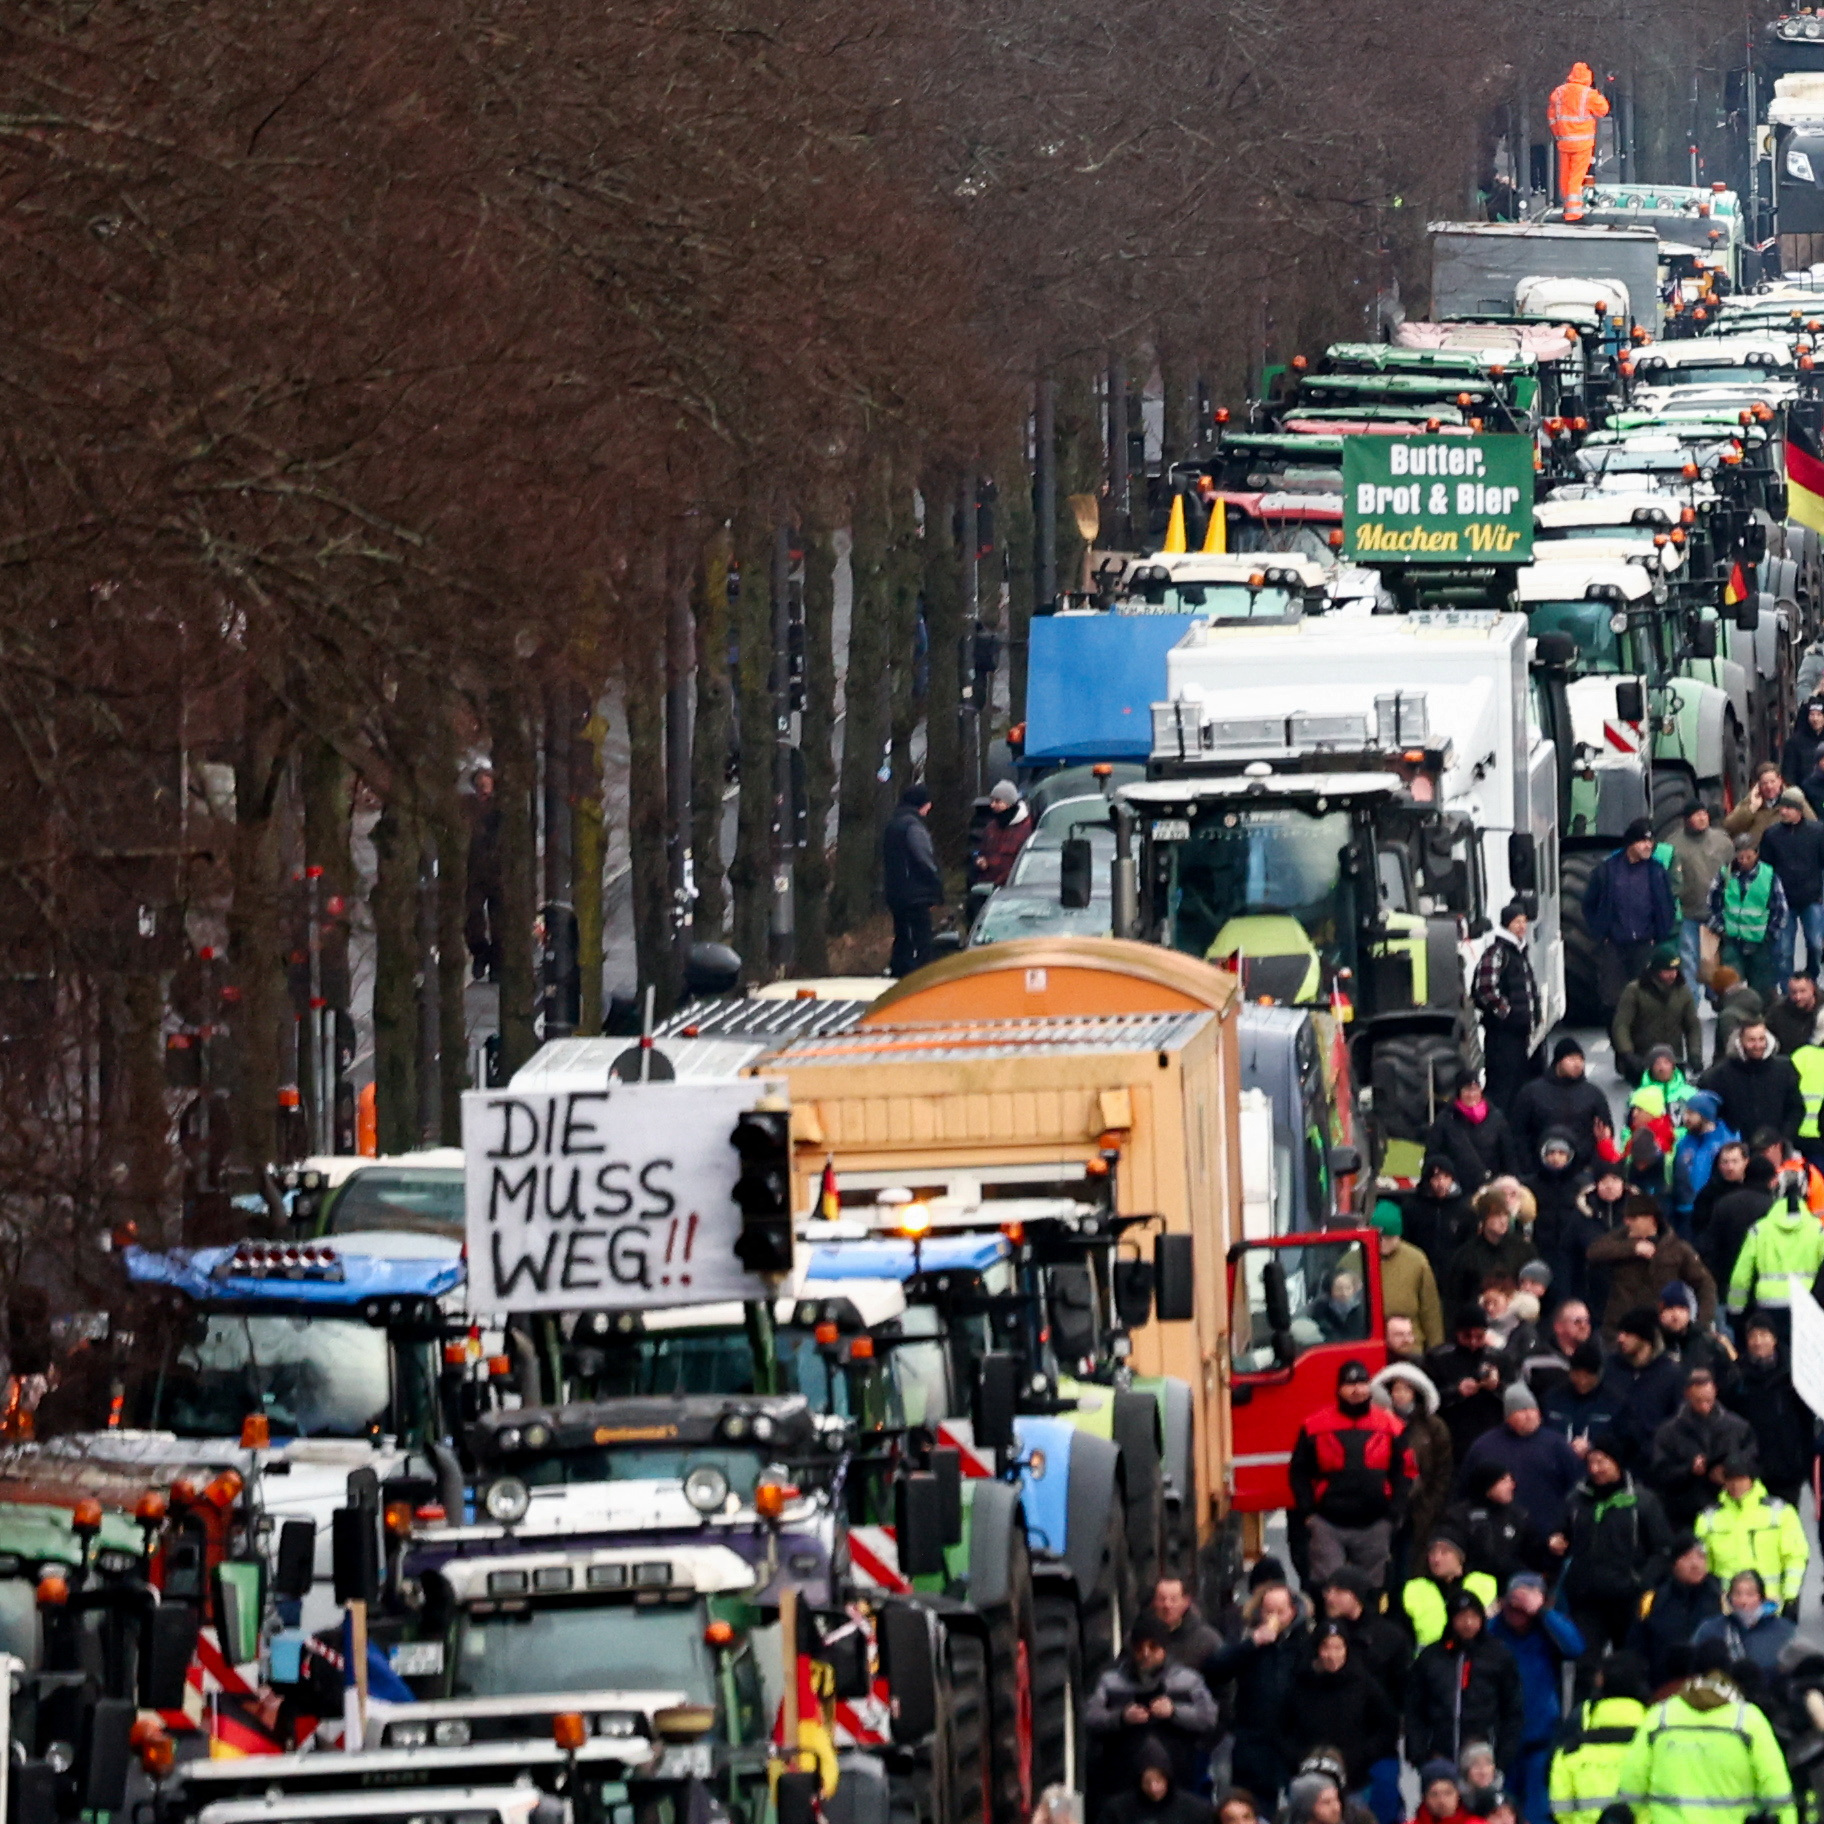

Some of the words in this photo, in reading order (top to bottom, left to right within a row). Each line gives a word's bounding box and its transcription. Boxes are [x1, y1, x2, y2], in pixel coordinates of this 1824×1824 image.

[1389, 442, 1486, 478] Butter,
[1357, 482, 1424, 515] Brot
[1428, 483, 1449, 515] &
[1456, 483, 1520, 516] Bier
[1356, 523, 1460, 553] Machen
[1464, 523, 1520, 553] Wir
[487, 1090, 611, 1160] DIE
[488, 1158, 678, 1223] MUSS
[491, 1211, 700, 1299] WEG!!
